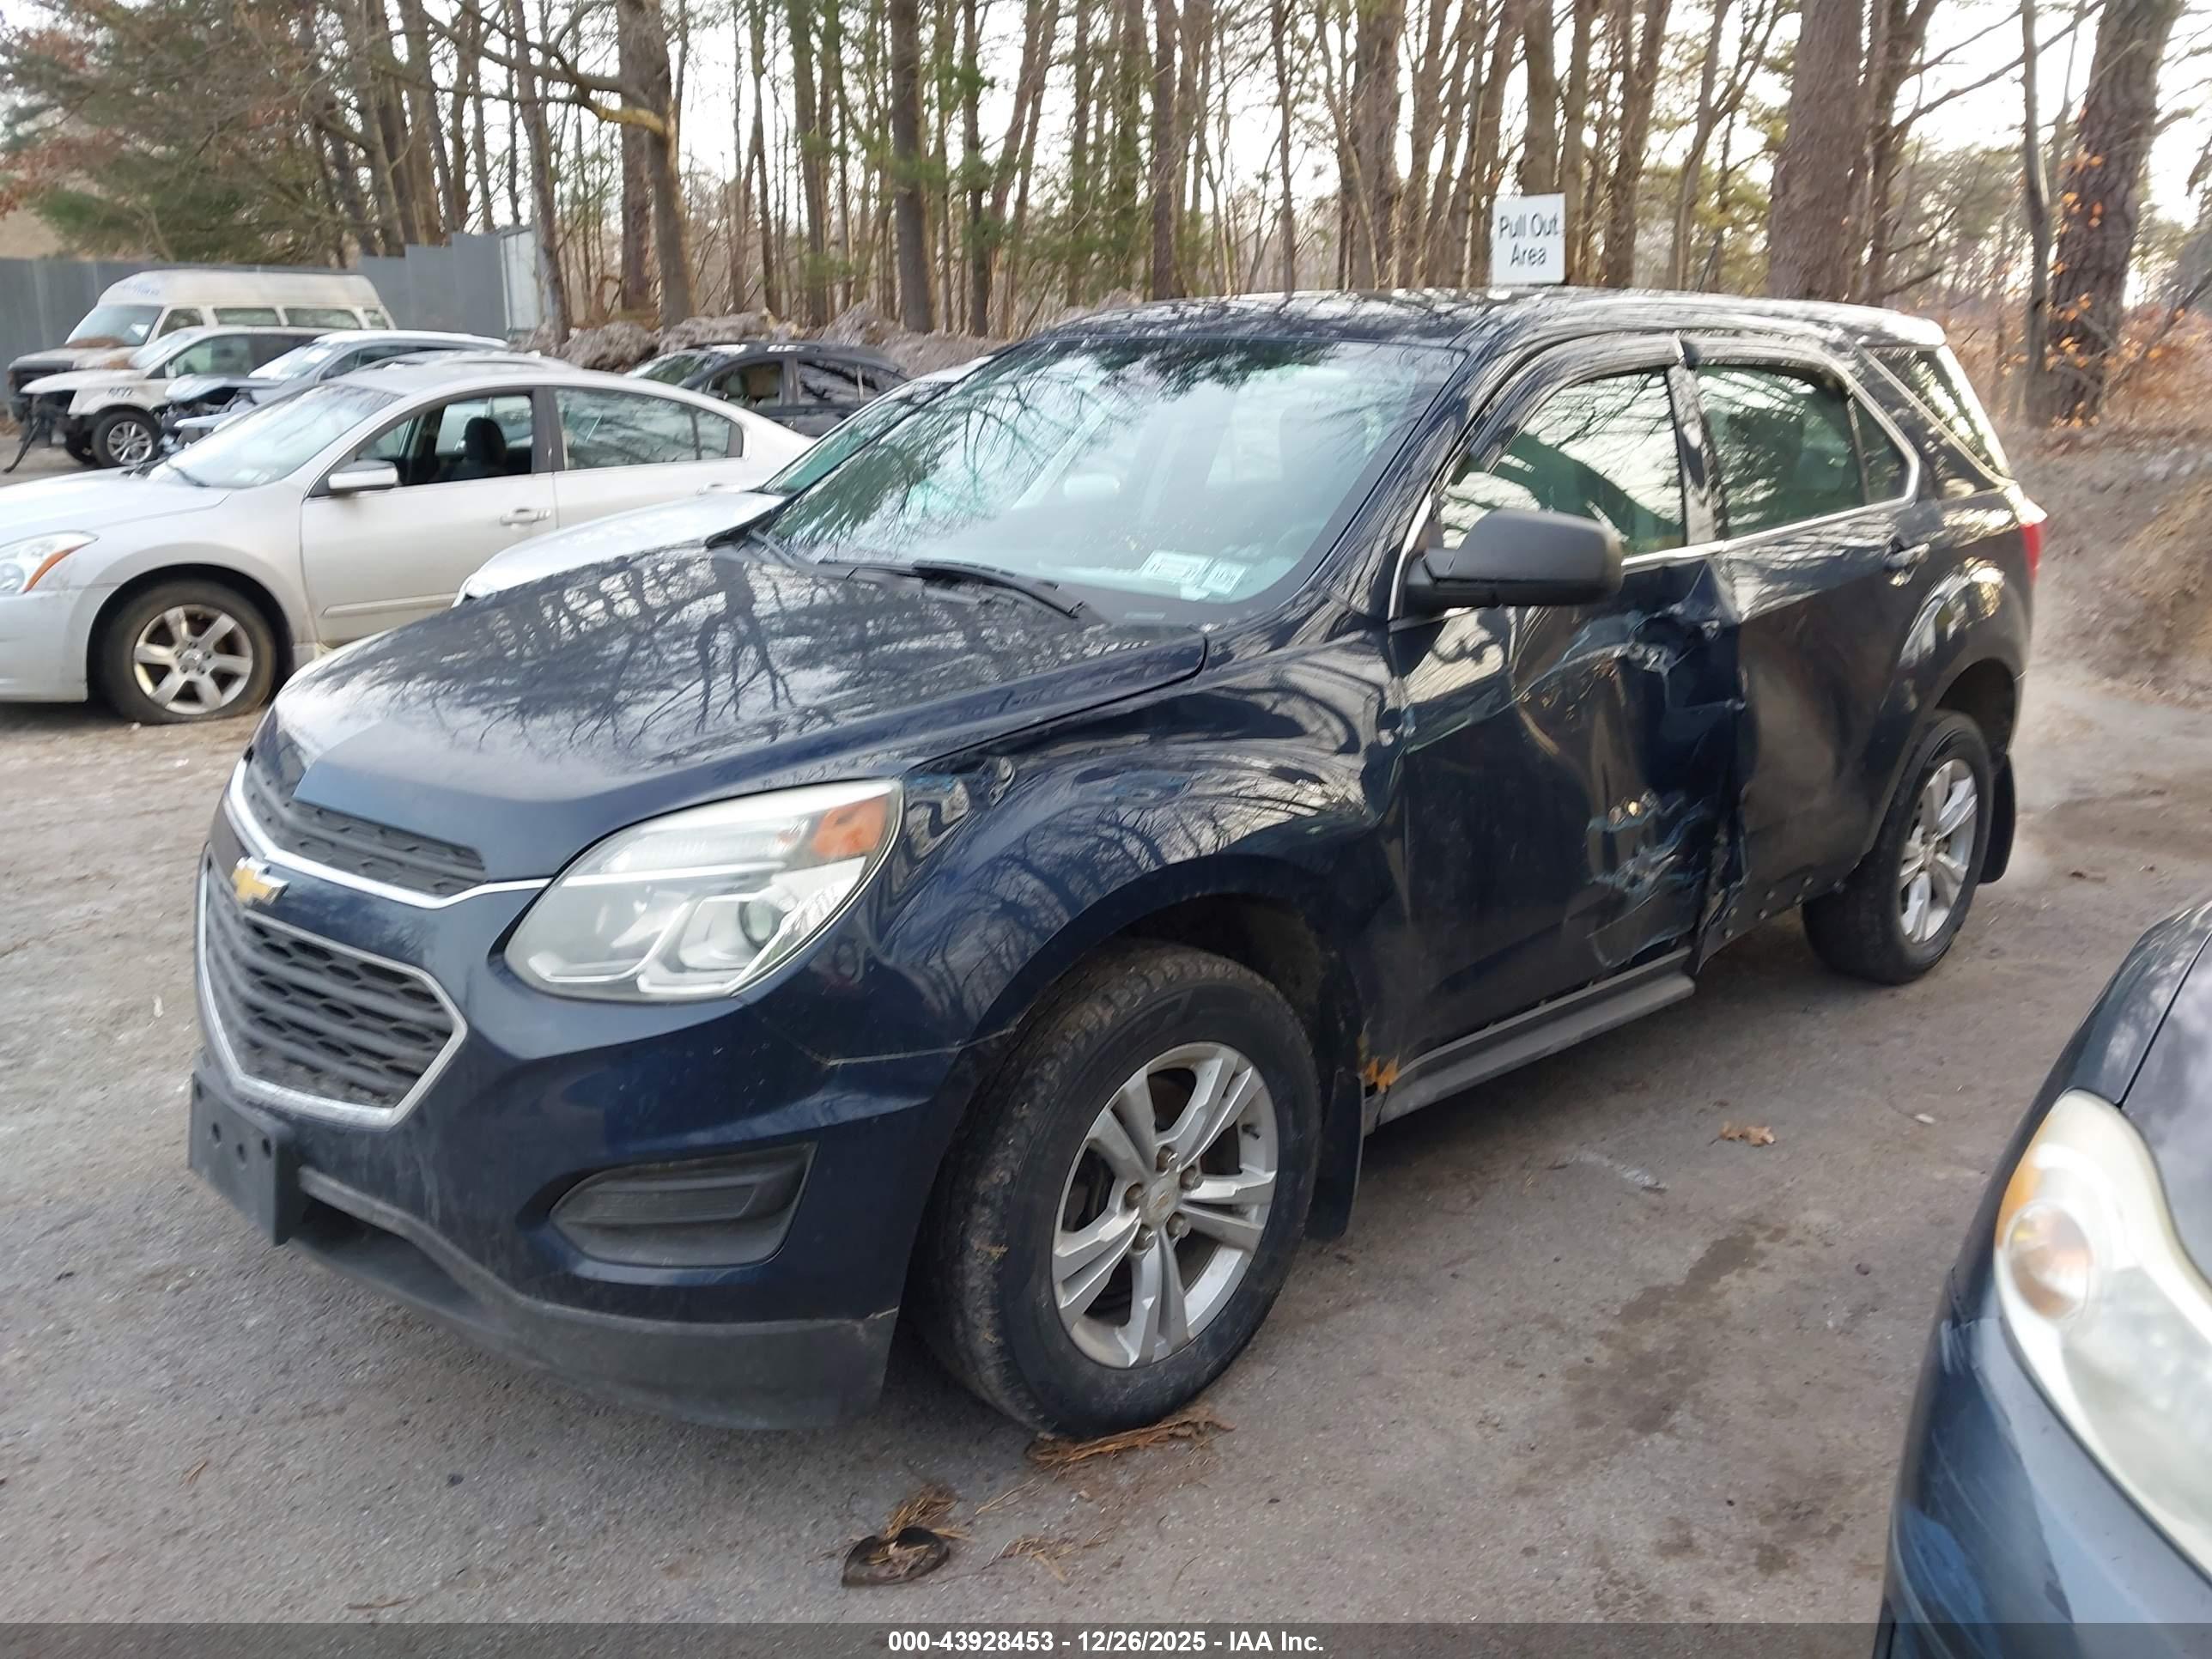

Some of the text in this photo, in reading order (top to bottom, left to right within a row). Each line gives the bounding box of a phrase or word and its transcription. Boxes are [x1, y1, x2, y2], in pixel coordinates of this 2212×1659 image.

[1499, 212, 1559, 240] Pull Out
[1510, 242, 1547, 267] Area
